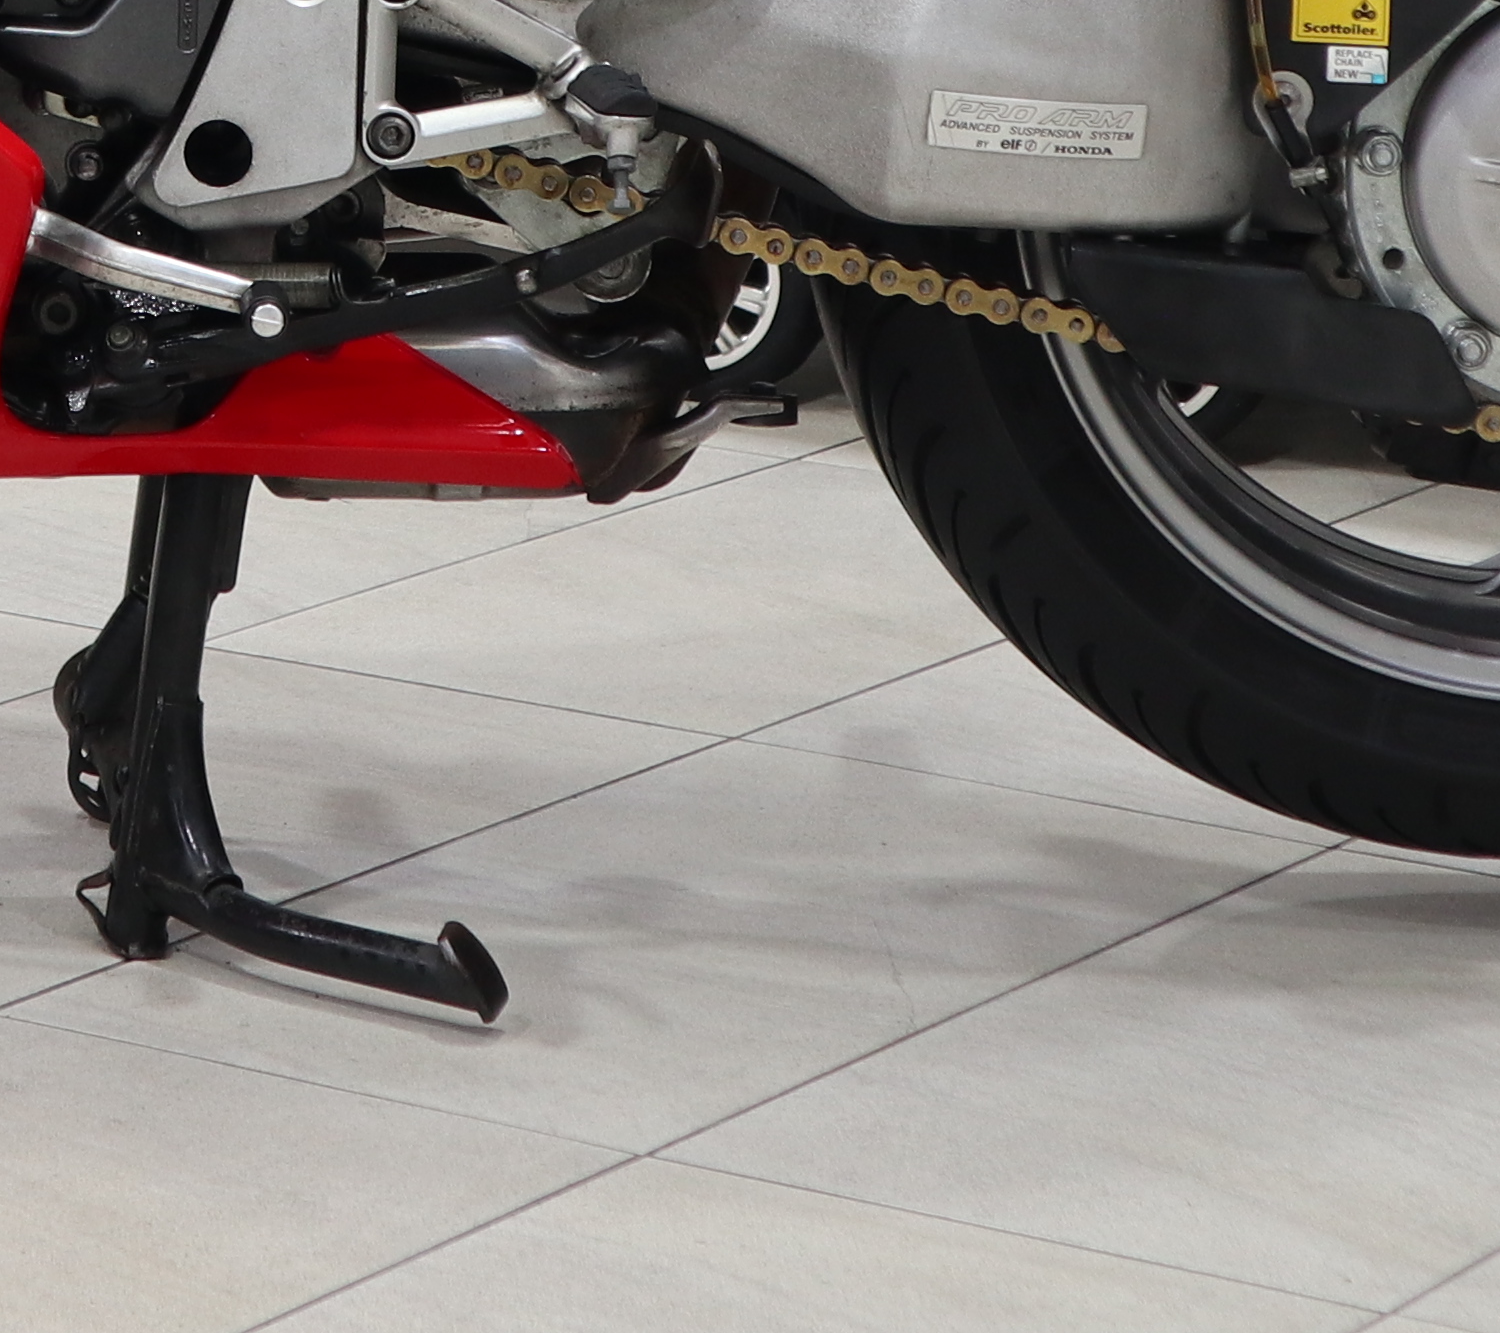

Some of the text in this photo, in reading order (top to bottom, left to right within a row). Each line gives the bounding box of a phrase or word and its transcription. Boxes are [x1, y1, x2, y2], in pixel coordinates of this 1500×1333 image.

[1303, 22, 1377, 36] Scottoiler
[1334, 49, 1374, 59] REPLACE
[1334, 58, 1364, 68] CHAIN
[1334, 70, 1360, 80] NEW
[947, 99, 1135, 130] PRO ARM
[939, 118, 1135, 142] ADVANCED SUSPENSION SYSTEM
[976, 138, 1114, 157] BY elf HONDA
